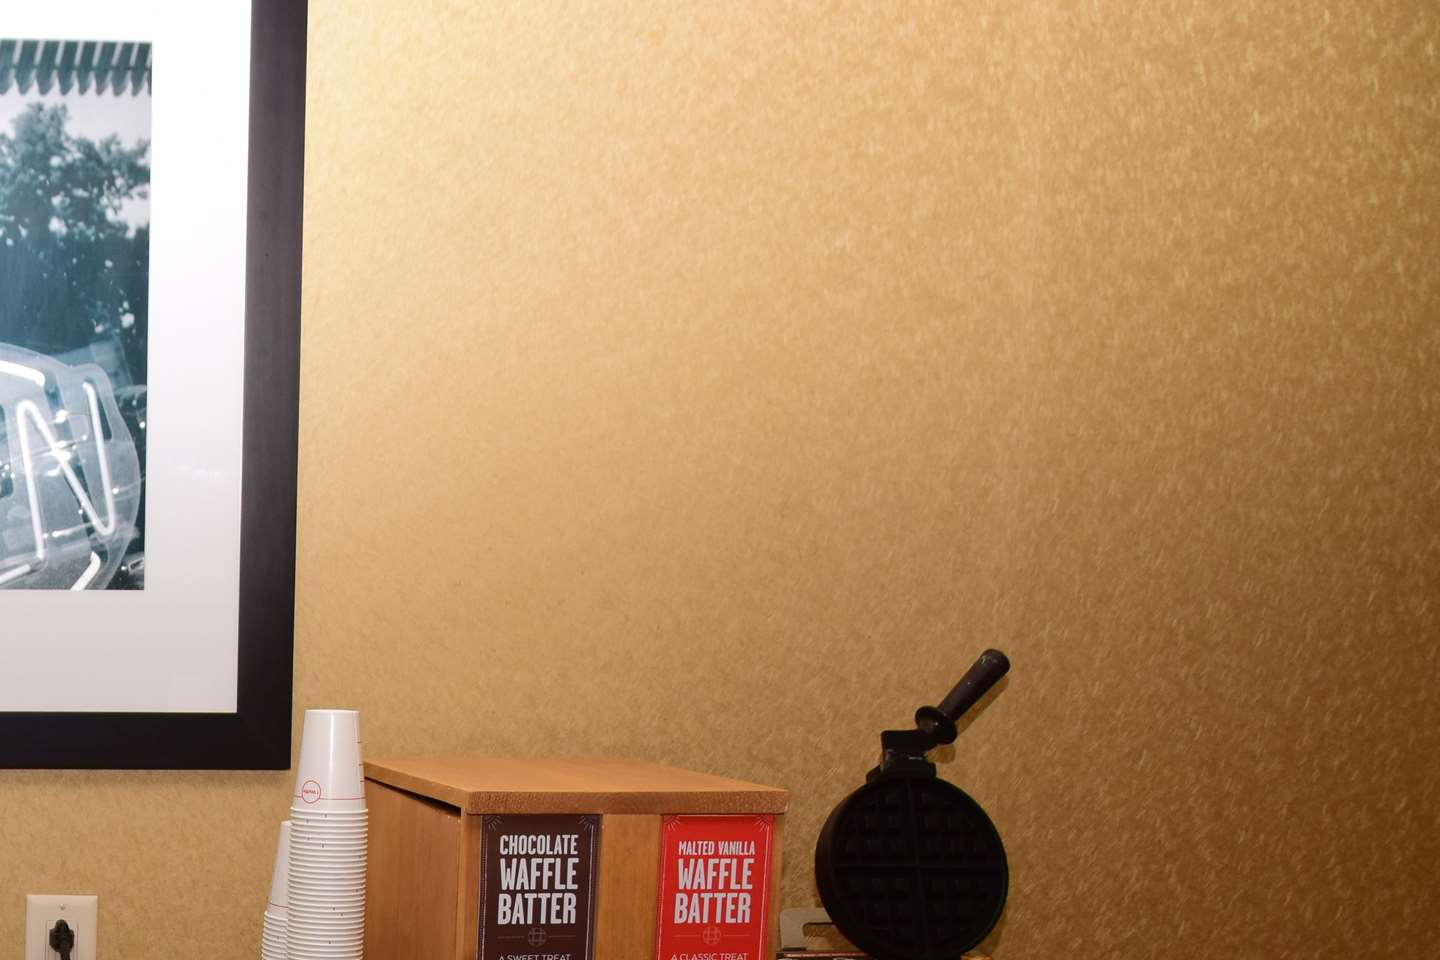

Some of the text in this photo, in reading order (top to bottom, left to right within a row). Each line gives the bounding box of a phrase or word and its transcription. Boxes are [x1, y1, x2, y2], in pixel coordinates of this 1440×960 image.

[499, 834, 579, 855] CHOCOLATE
[678, 840, 755, 855] MALTED VANILLA
[500, 857, 579, 890] WAFFLE
[678, 858, 755, 890] WAFFLE
[497, 893, 577, 925] BATTER
[673, 893, 751, 924] BATTER
[671, 953, 678, 960] A
[720, 952, 748, 960] TREAT
